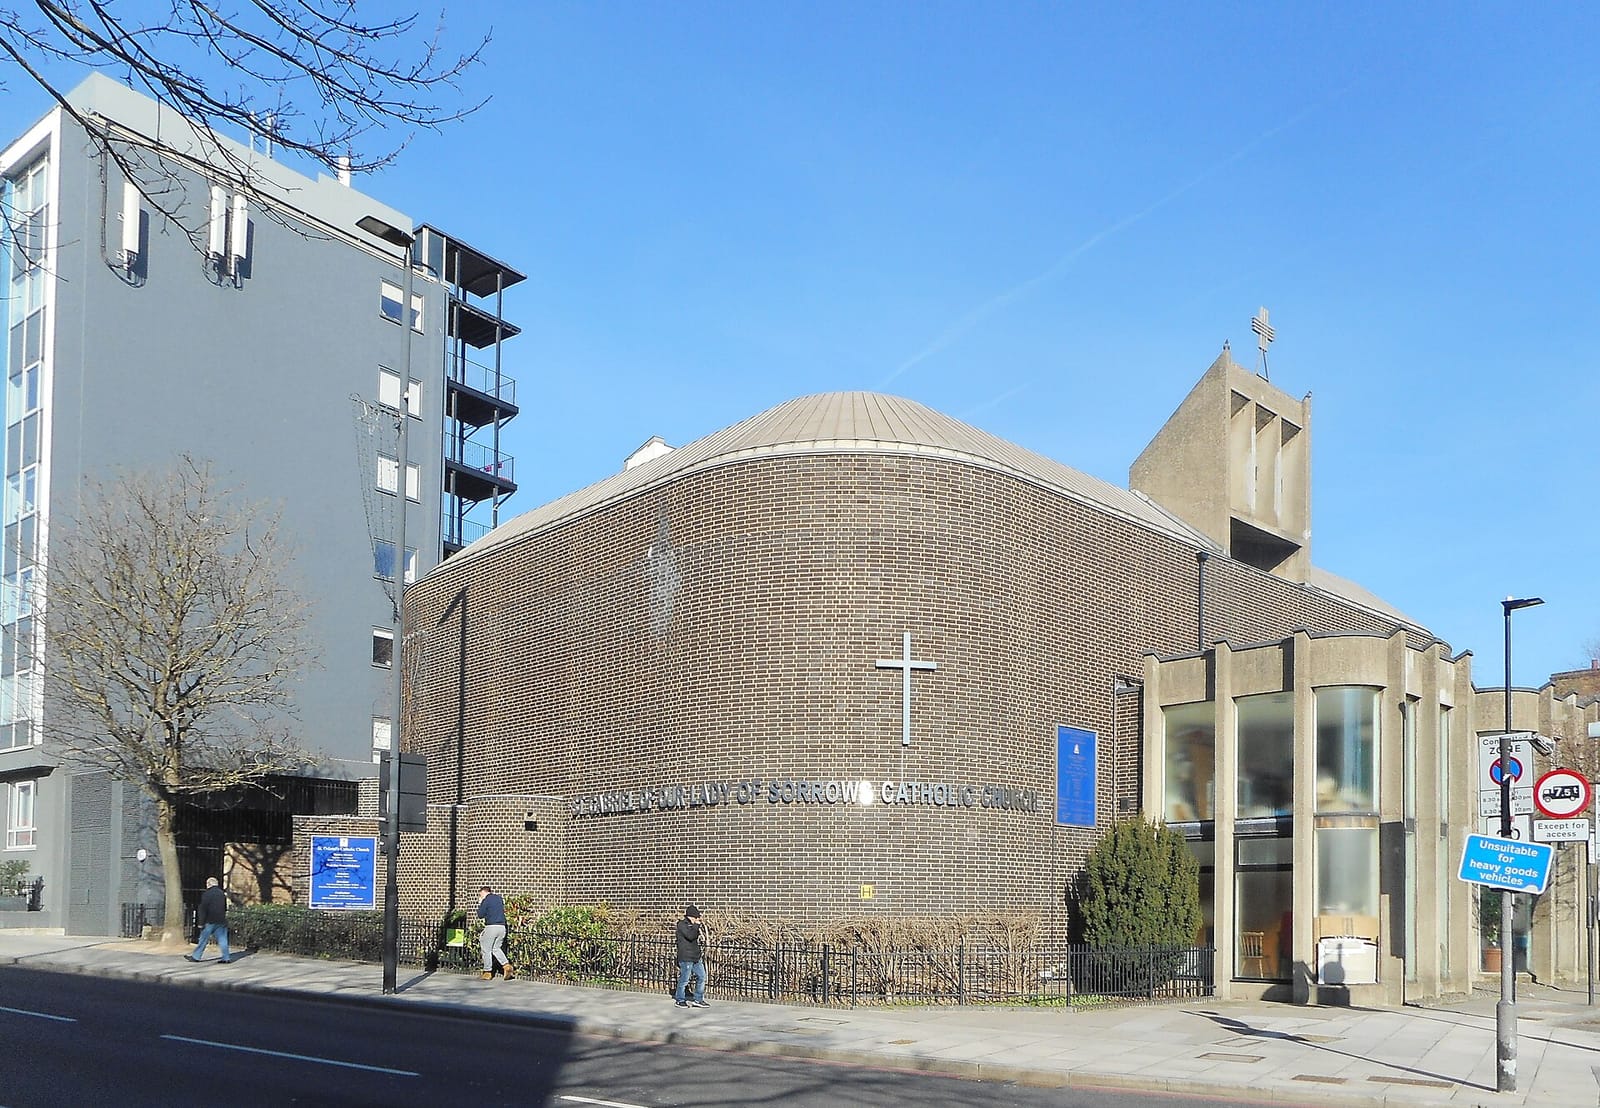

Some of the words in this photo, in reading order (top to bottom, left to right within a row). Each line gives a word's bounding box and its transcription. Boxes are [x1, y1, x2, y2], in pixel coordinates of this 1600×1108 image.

[658, 785, 685, 809] OUR
[690, 782, 730, 806] LADY
[737, 779, 761, 804] OF
[881, 781, 974, 807] CATHOLIC
[981, 785, 1038, 813] CHURCH
[1554, 787, 1571, 797] 7.5
[1538, 823, 1568, 831] Except
[1480, 840, 1538, 857] Unsuitable
[1498, 853, 1515, 863] for
[1470, 860, 1501, 872] heavy
[1504, 865, 1538, 878] goods
[1479, 871, 1523, 885] vehicles
[863, 887, 870, 897] H
